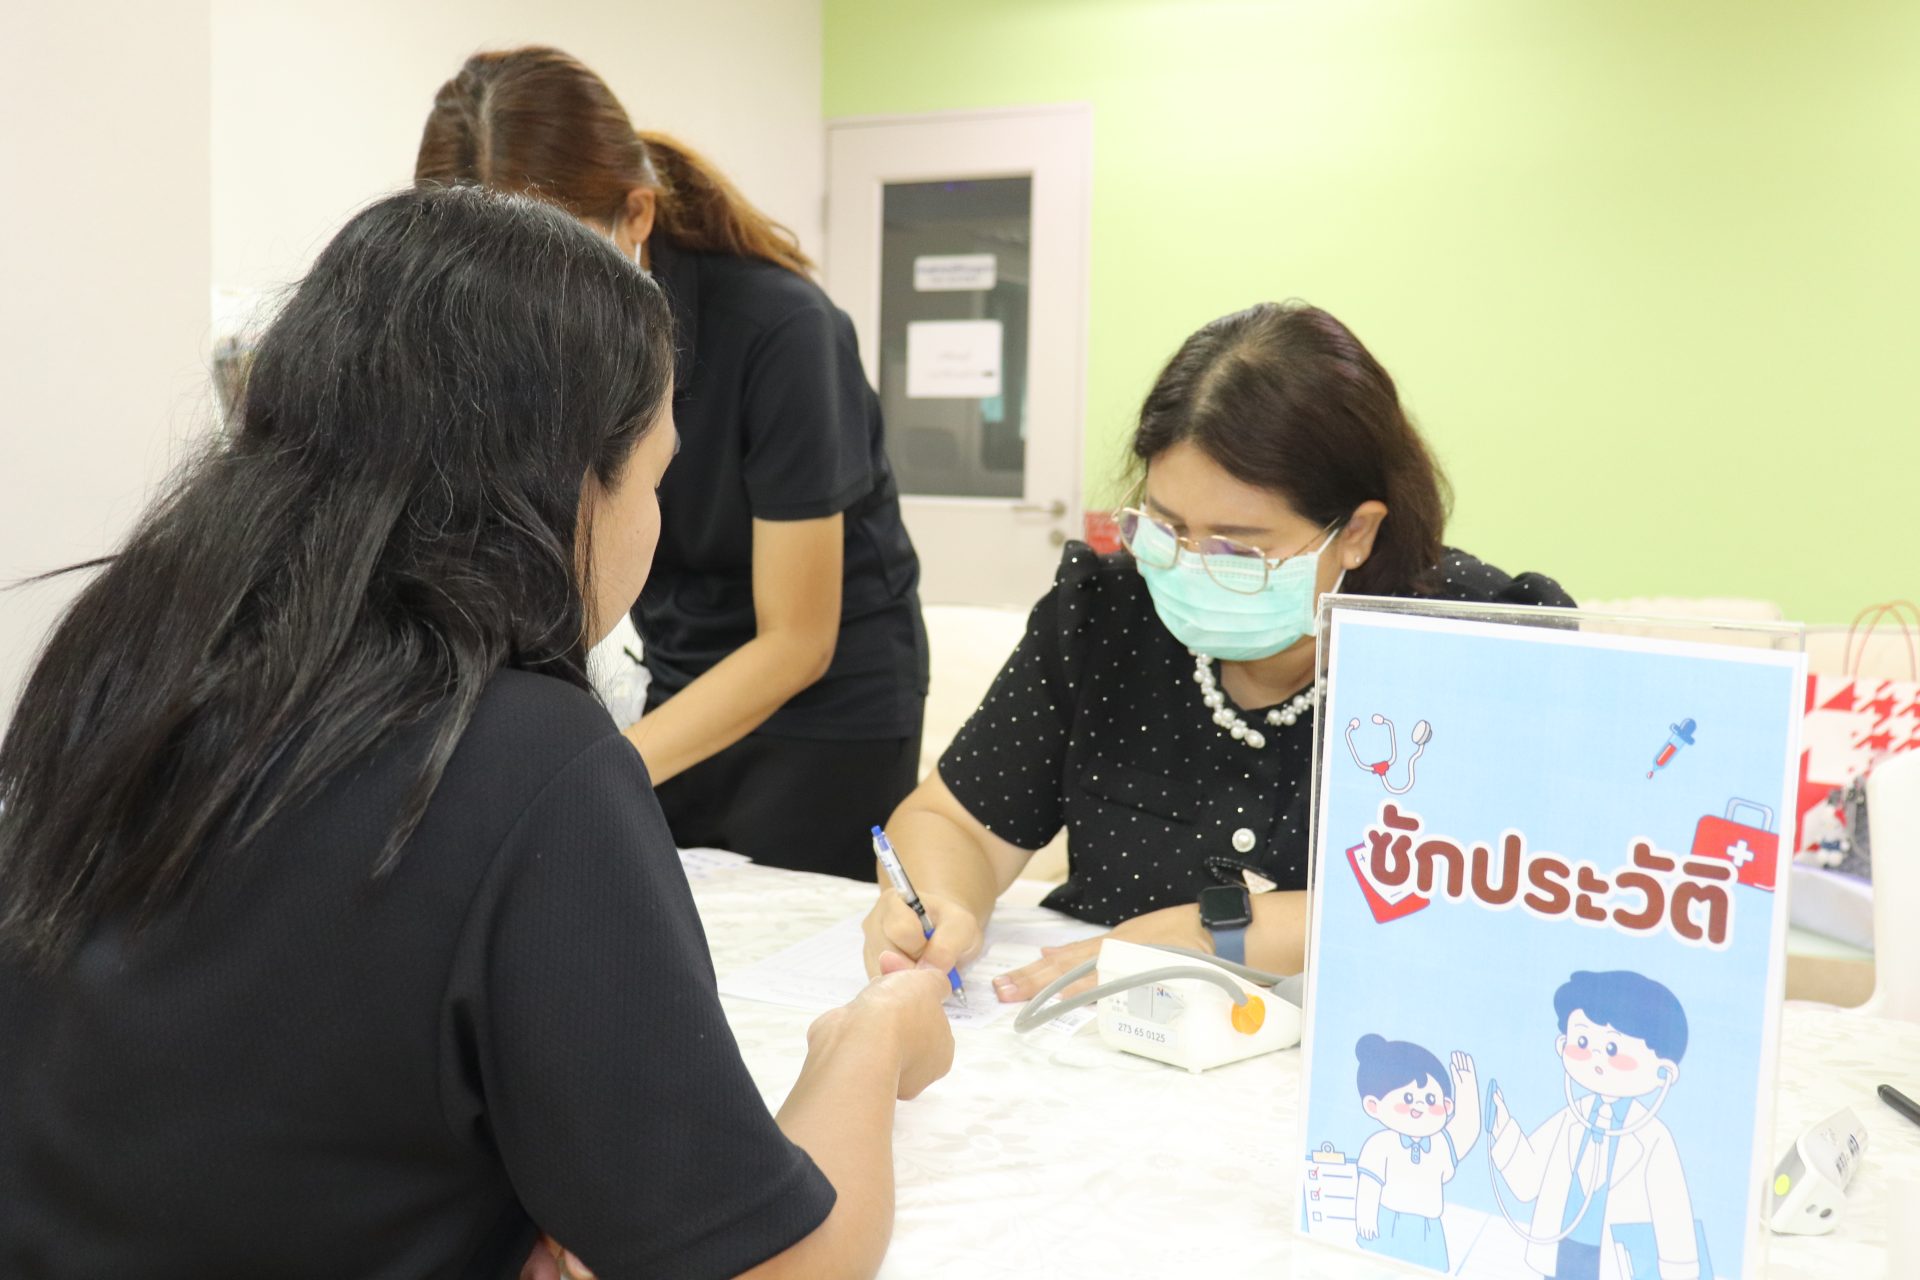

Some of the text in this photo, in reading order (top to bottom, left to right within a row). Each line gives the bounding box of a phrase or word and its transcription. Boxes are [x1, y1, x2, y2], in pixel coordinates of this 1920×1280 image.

[1368, 803, 1731, 945] ซักประวัติ
[1117, 1022, 1166, 1043] 273 65 0125
